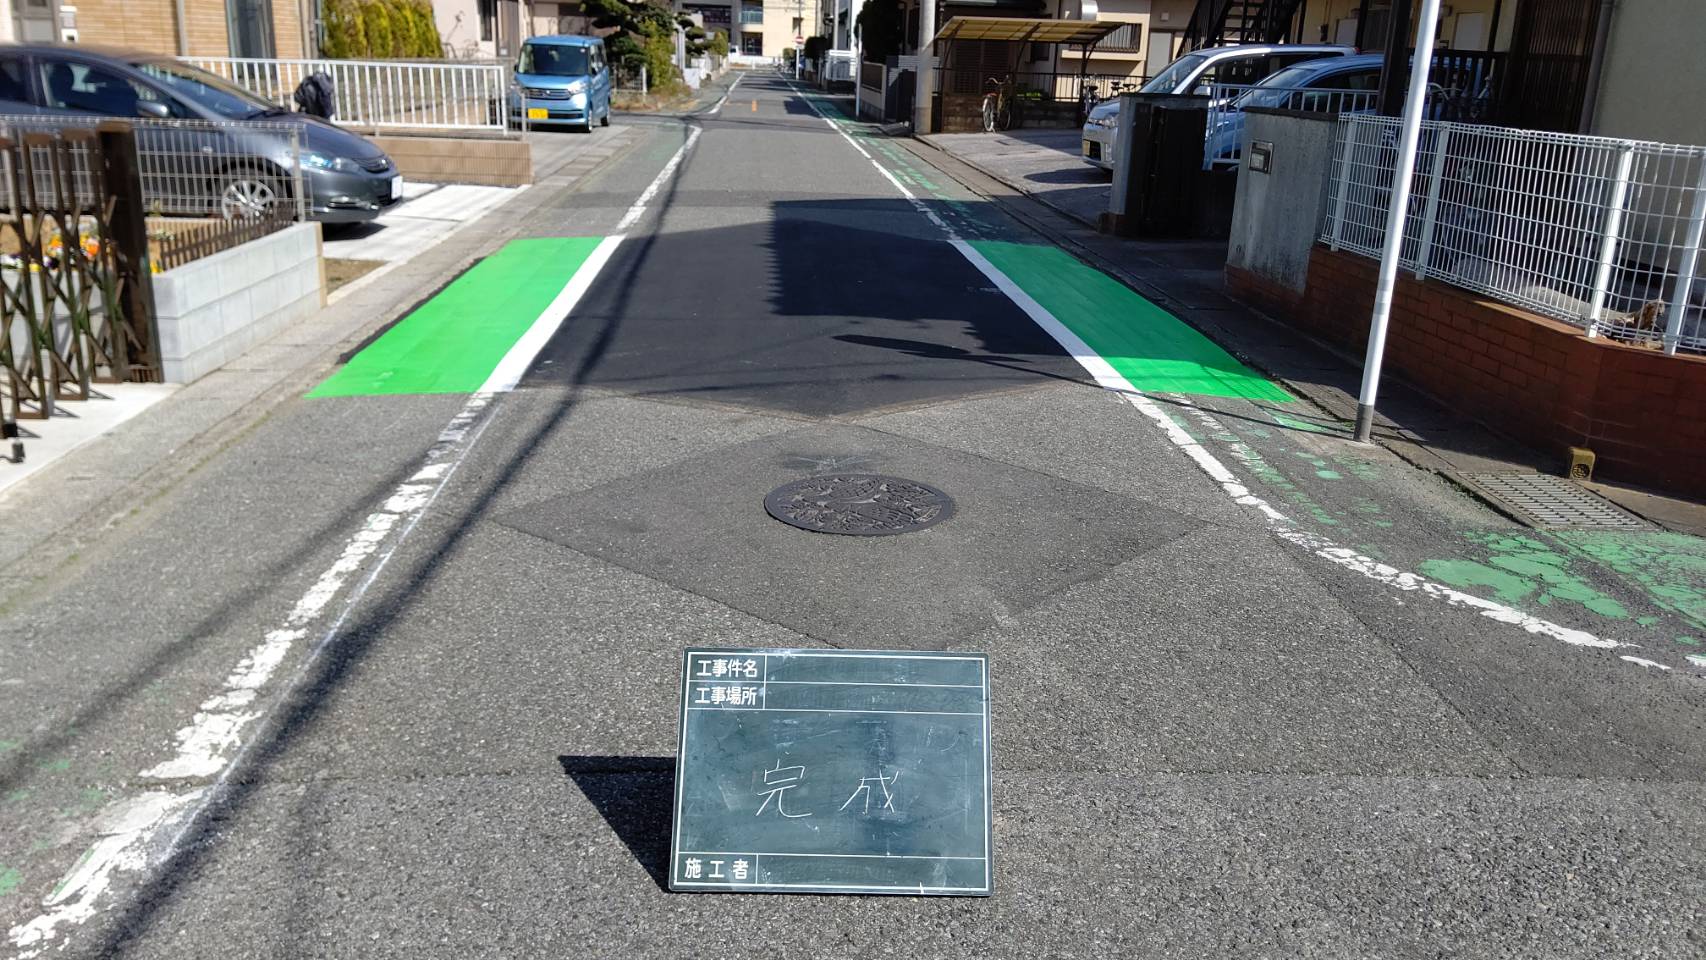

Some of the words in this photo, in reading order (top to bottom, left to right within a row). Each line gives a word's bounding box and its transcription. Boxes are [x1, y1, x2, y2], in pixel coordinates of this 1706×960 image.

[696, 658, 758, 678] 工事件名
[694, 686, 757, 706] 工事場所
[684, 857, 749, 880] 施工者
